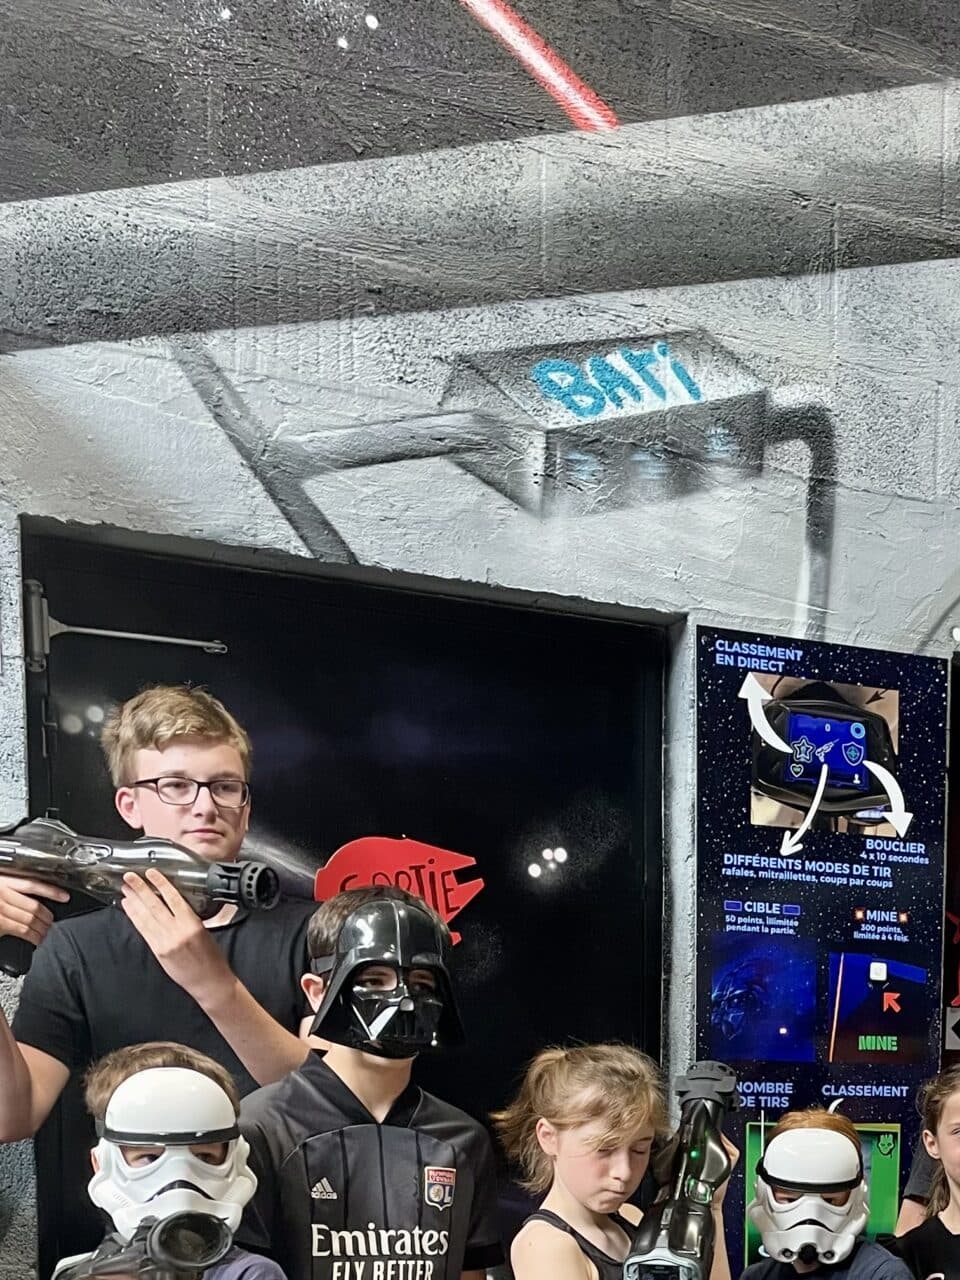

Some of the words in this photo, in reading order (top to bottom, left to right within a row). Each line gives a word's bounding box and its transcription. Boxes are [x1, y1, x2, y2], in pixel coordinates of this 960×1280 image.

[715, 640, 803, 661] CLASSEMENT
[715, 653, 734, 666] EN
[738, 655, 785, 672] DIRECT
[865, 838, 926, 855] BOUCLIER
[723, 853, 802, 871] DIFFÉRENTS
[805, 860, 850, 875] MODES
[853, 864, 870, 876] DE
[872, 865, 892, 878] TIR
[860, 851, 868, 860] 4
[876, 852, 887, 862] 10
[887, 854, 929, 866] secondes
[721, 867, 757, 878] rafales,
[758, 869, 818, 883] mitraillettes,
[820, 876, 848, 886] coups
[849, 877, 865, 887] par
[866, 878, 893, 889] coups
[744, 901, 781, 914] CIBLE
[866, 909, 897, 922] MINE
[726, 924, 760, 933] pendant
[858, 1035, 898, 1051] MINE
[736, 1082, 794, 1095] NOMBRE
[821, 1084, 909, 1097] CLASSEMENT
[739, 1096, 756, 1107] DE
[759, 1096, 790, 1108] TIRS
[311, 1222, 449, 1257] Emirates
